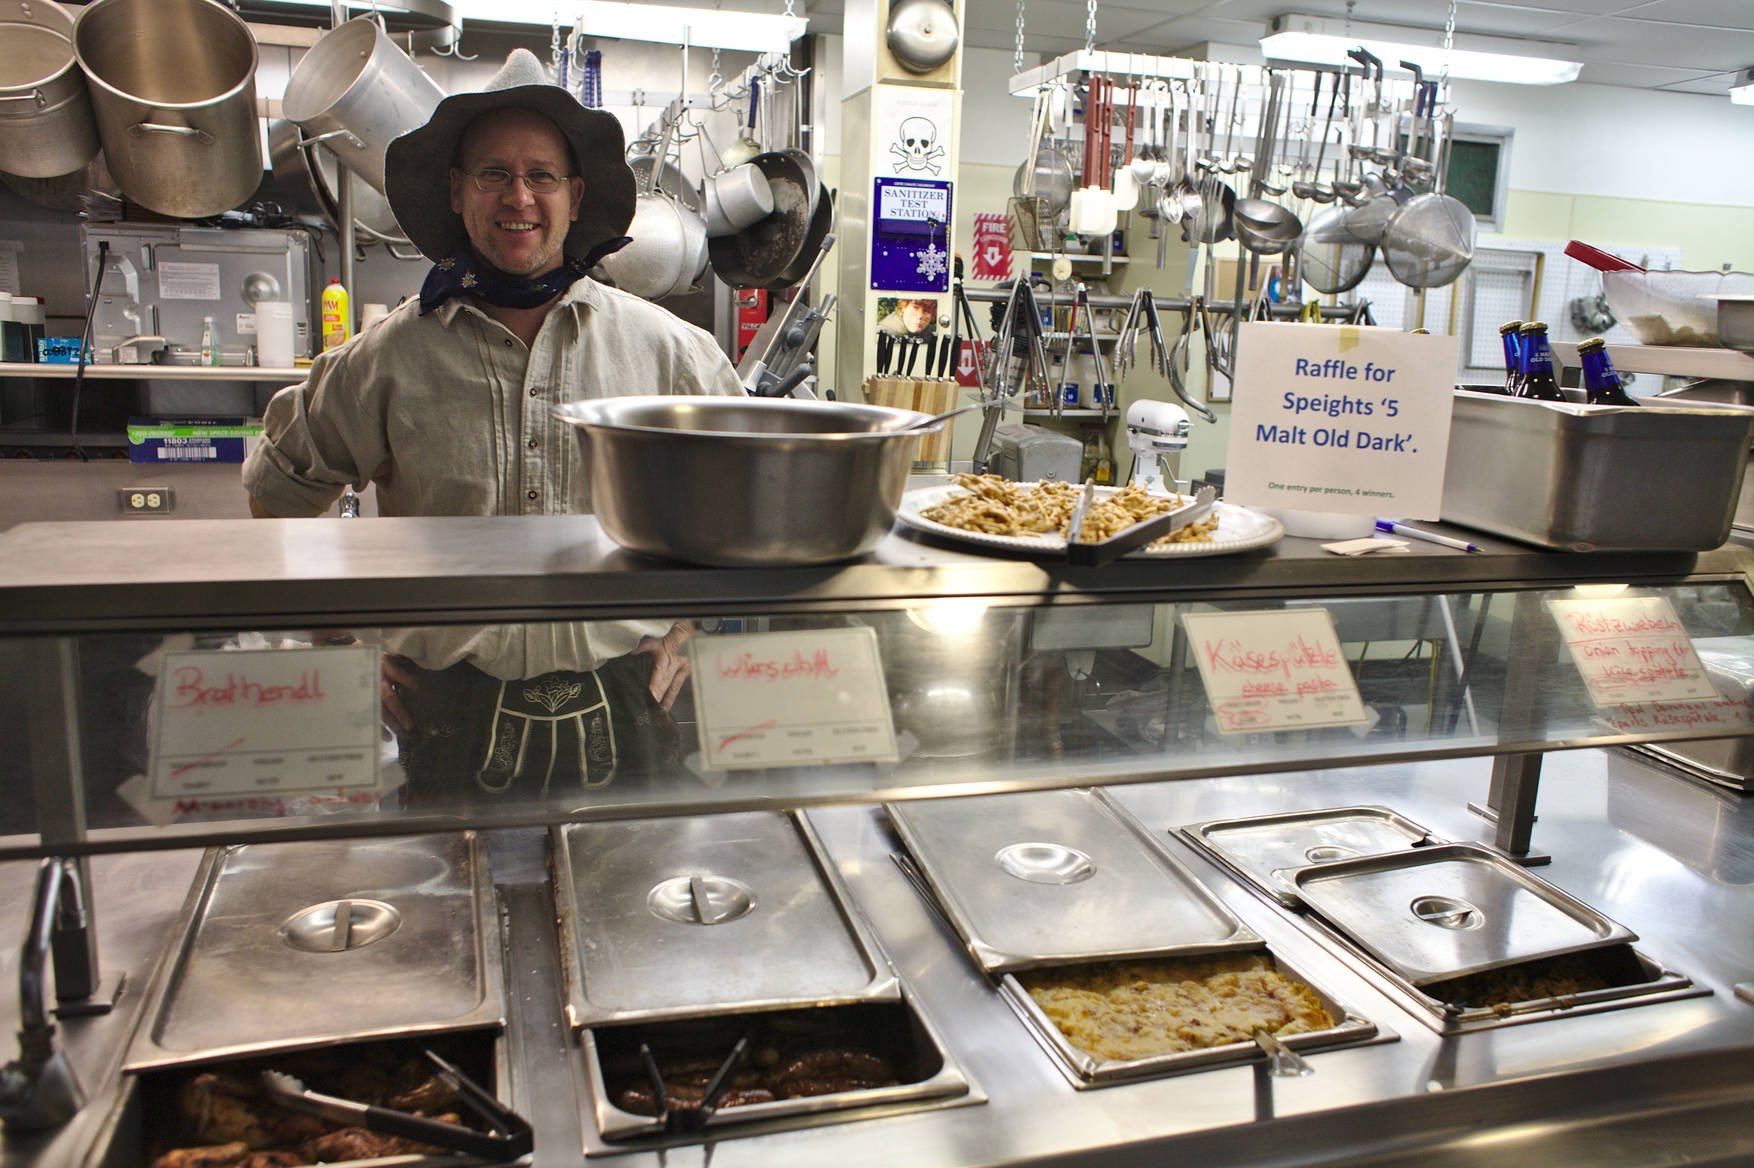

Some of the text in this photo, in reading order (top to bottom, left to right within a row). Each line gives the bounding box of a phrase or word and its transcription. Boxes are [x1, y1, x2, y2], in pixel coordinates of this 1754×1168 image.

[884, 188, 945, 201] SANITIZER
[901, 199, 928, 210] TEST
[890, 208, 937, 219] STATION
[982, 222, 1007, 233] FIRE
[1295, 358, 1396, 383] Raffle for
[1282, 391, 1374, 417] Speights
[1256, 424, 1306, 445] Malt
[1313, 428, 1350, 448] Old
[1268, 481, 1395, 498] One entry per person, 4 winners.
[170, 665, 327, 709] Brathendl
